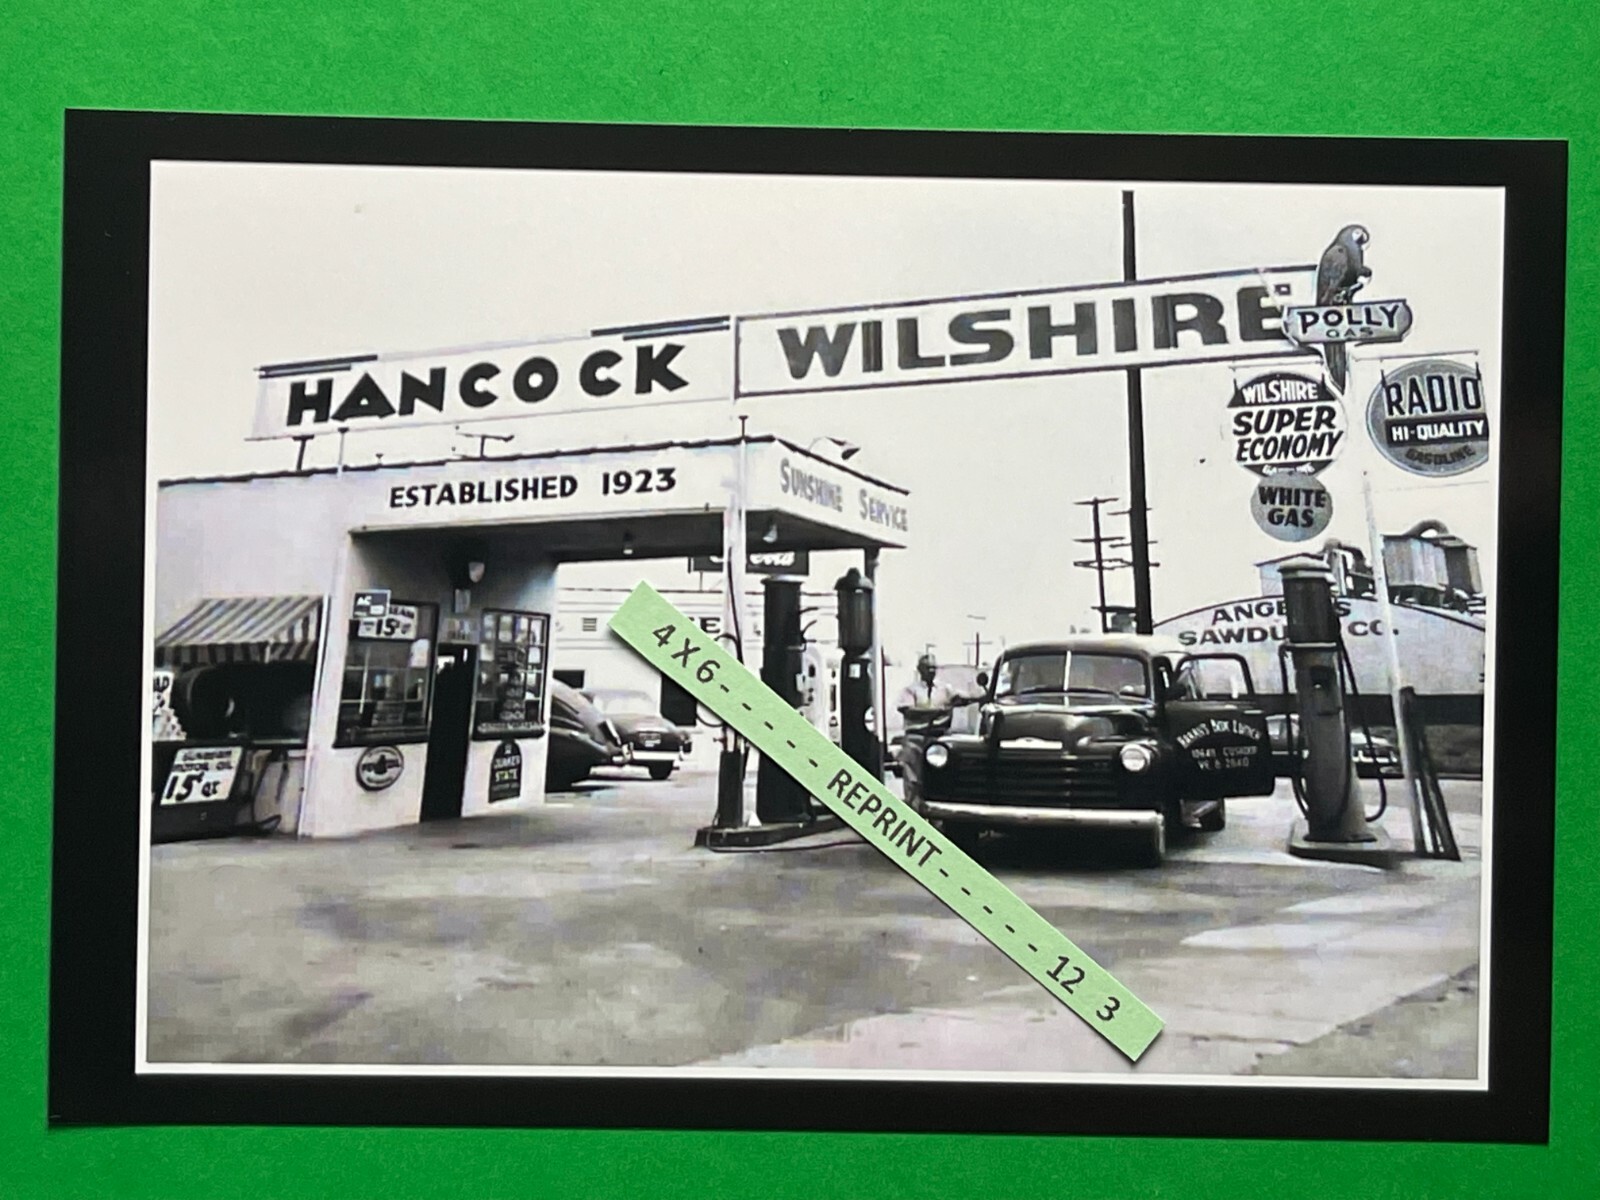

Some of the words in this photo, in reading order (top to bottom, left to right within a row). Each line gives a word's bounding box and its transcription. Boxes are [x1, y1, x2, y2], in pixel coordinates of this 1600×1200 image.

[777, 283, 1290, 380] WILSHIRE
[1297, 304, 1399, 335] POLLY
[1326, 326, 1374, 339] GAS
[285, 343, 689, 427] HANCOCK
[1241, 379, 1319, 404] WILSHIRE
[1384, 374, 1482, 417] RADIO
[1232, 404, 1337, 436] SUPER
[1391, 419, 1486, 442] HI-QUALITY
[1235, 430, 1344, 463] ECONOMY
[1404, 444, 1477, 466] GASOLINE
[389, 474, 579, 509] ESTABLISHED
[601, 467, 677, 496] 1923
[780, 457, 843, 513] SUNSHINE
[859, 488, 908, 532] SERVICE
[1258, 485, 1327, 508] WHITE
[1267, 507, 1315, 528] GAS
[1211, 600, 1351, 626] ANGES
[1178, 623, 1288, 646] SAWDU
[651, 623, 677, 648] 4
[670, 637, 701, 668] X
[696, 658, 721, 684] 6
[827, 768, 943, 868] REPRINT
[1046, 955, 1086, 995] 12
[1095, 996, 1121, 1022] 3
